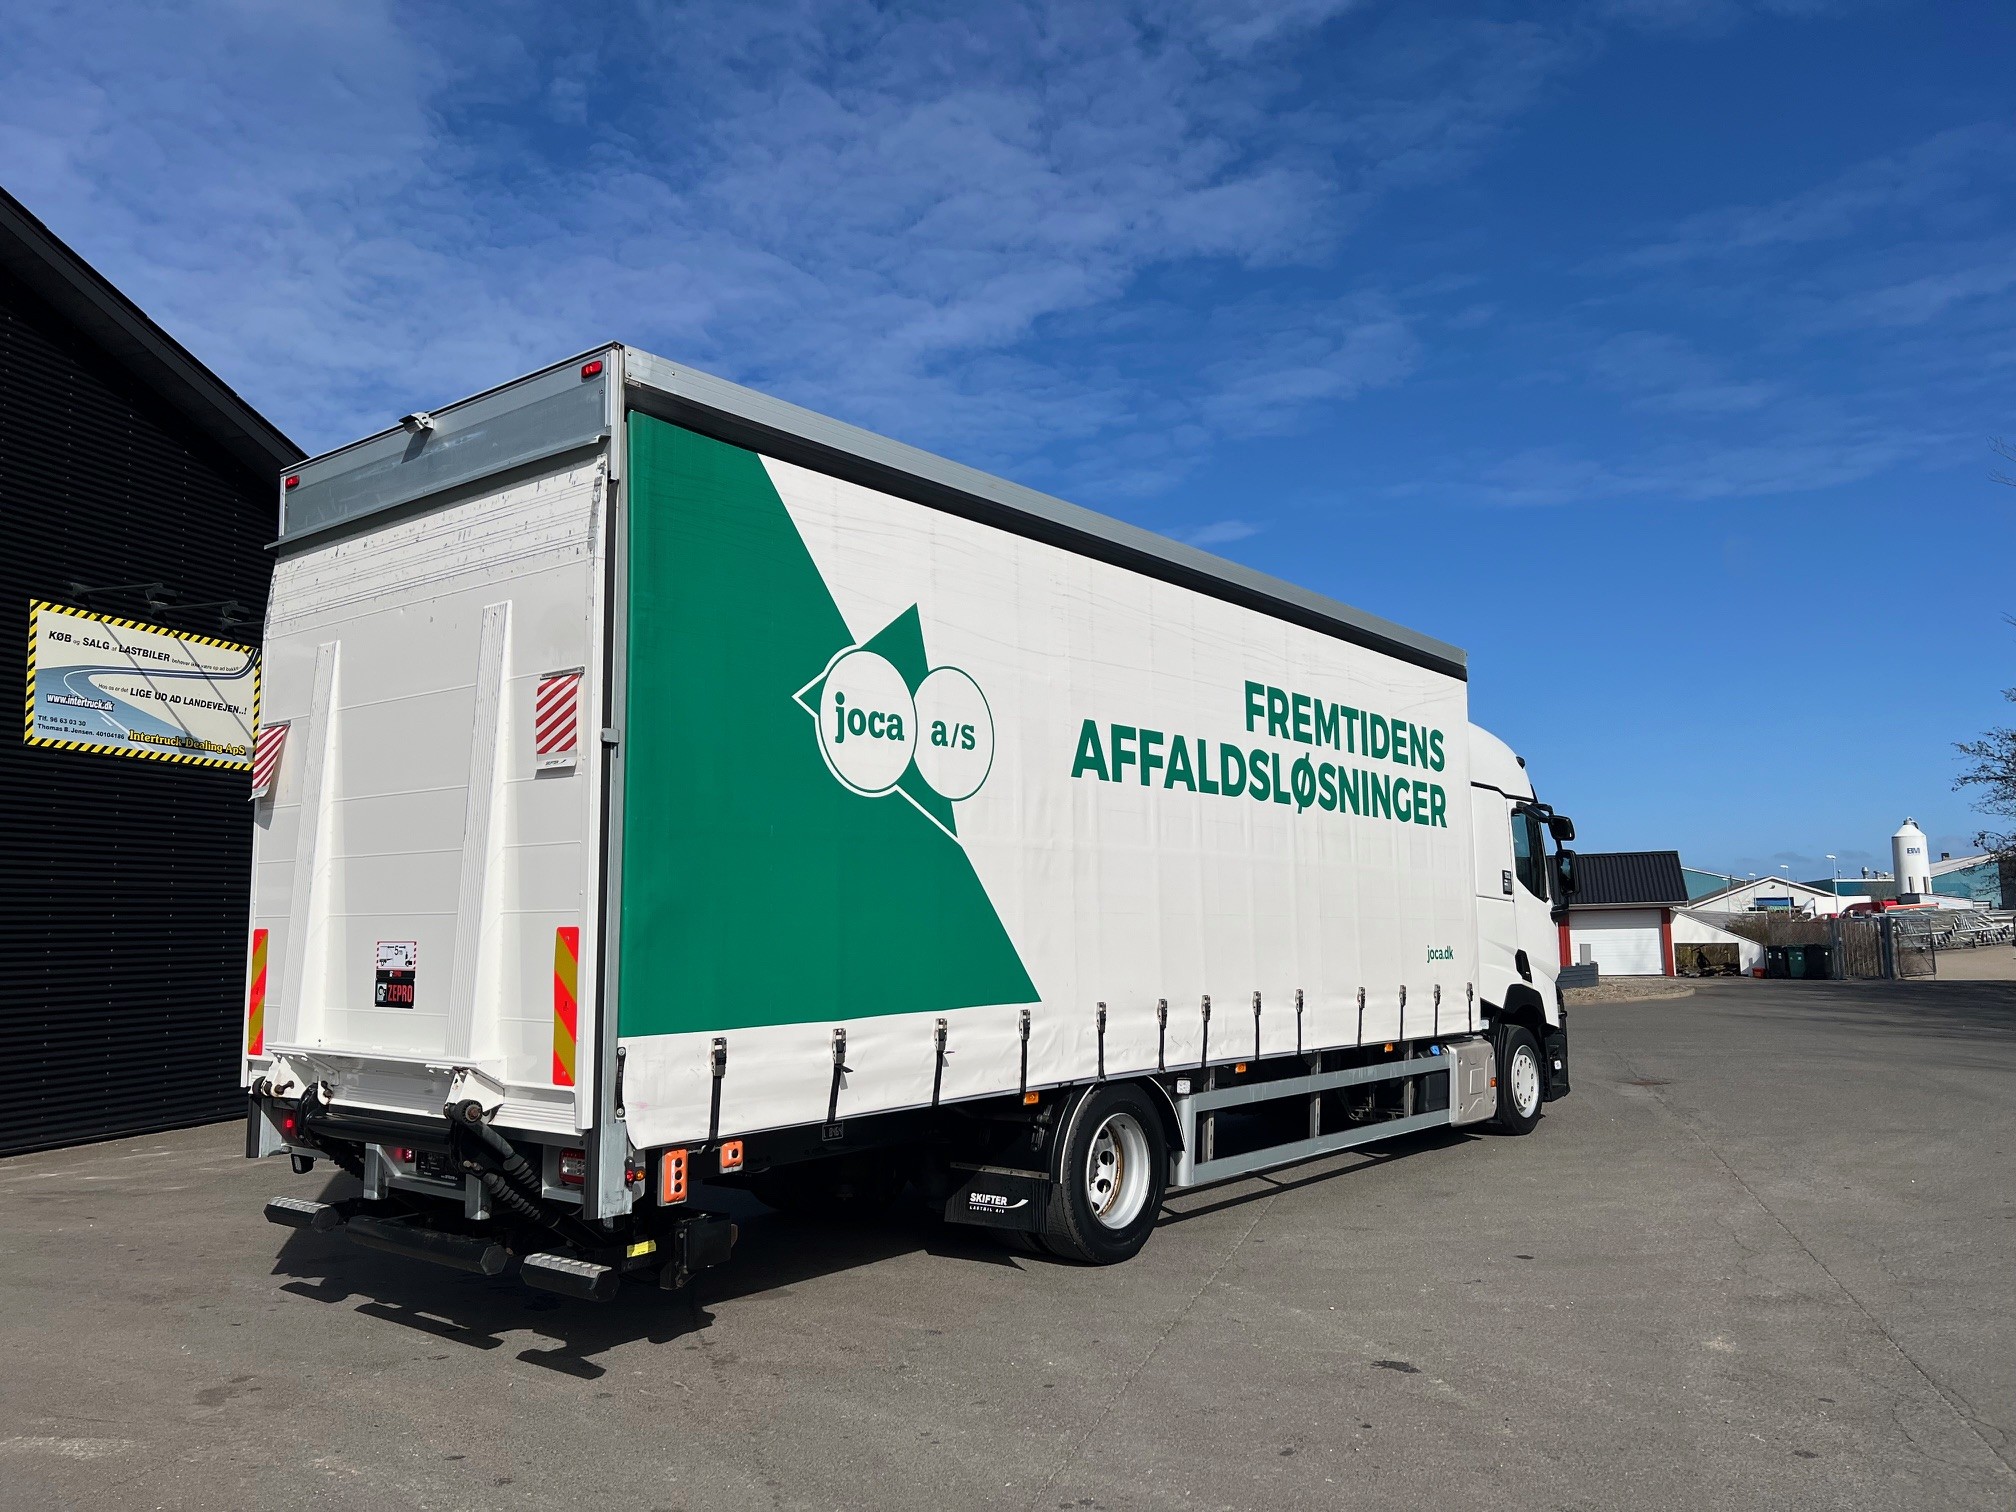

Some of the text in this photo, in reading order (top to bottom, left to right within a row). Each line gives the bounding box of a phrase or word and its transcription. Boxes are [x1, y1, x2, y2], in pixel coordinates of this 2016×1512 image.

[48, 630, 72, 643] KØB
[82, 637, 110, 650] SALG
[118, 644, 170, 662] LASTBILER
[46, 693, 114, 711] www.intertruck.dk
[129, 687, 152, 699] LIGE
[154, 691, 168, 702] UD
[169, 694, 182, 704] AD
[37, 714, 48, 722] Tlf.
[68, 718, 77, 726] 03
[78, 719, 87, 727] 30
[37, 723, 63, 732] Thomas
[834, 691, 976, 751] joca a/s
[1244, 679, 1445, 773] FREMTIDENS
[128, 729, 246, 756] Intertruck Dealing ApS
[1071, 718, 1448, 829] AFFALDSLØSNINGER
[1427, 944, 1454, 964] joca.dk
[387, 984, 413, 1003] ZEPRO
[970, 1192, 1008, 1206] SKIFTER
